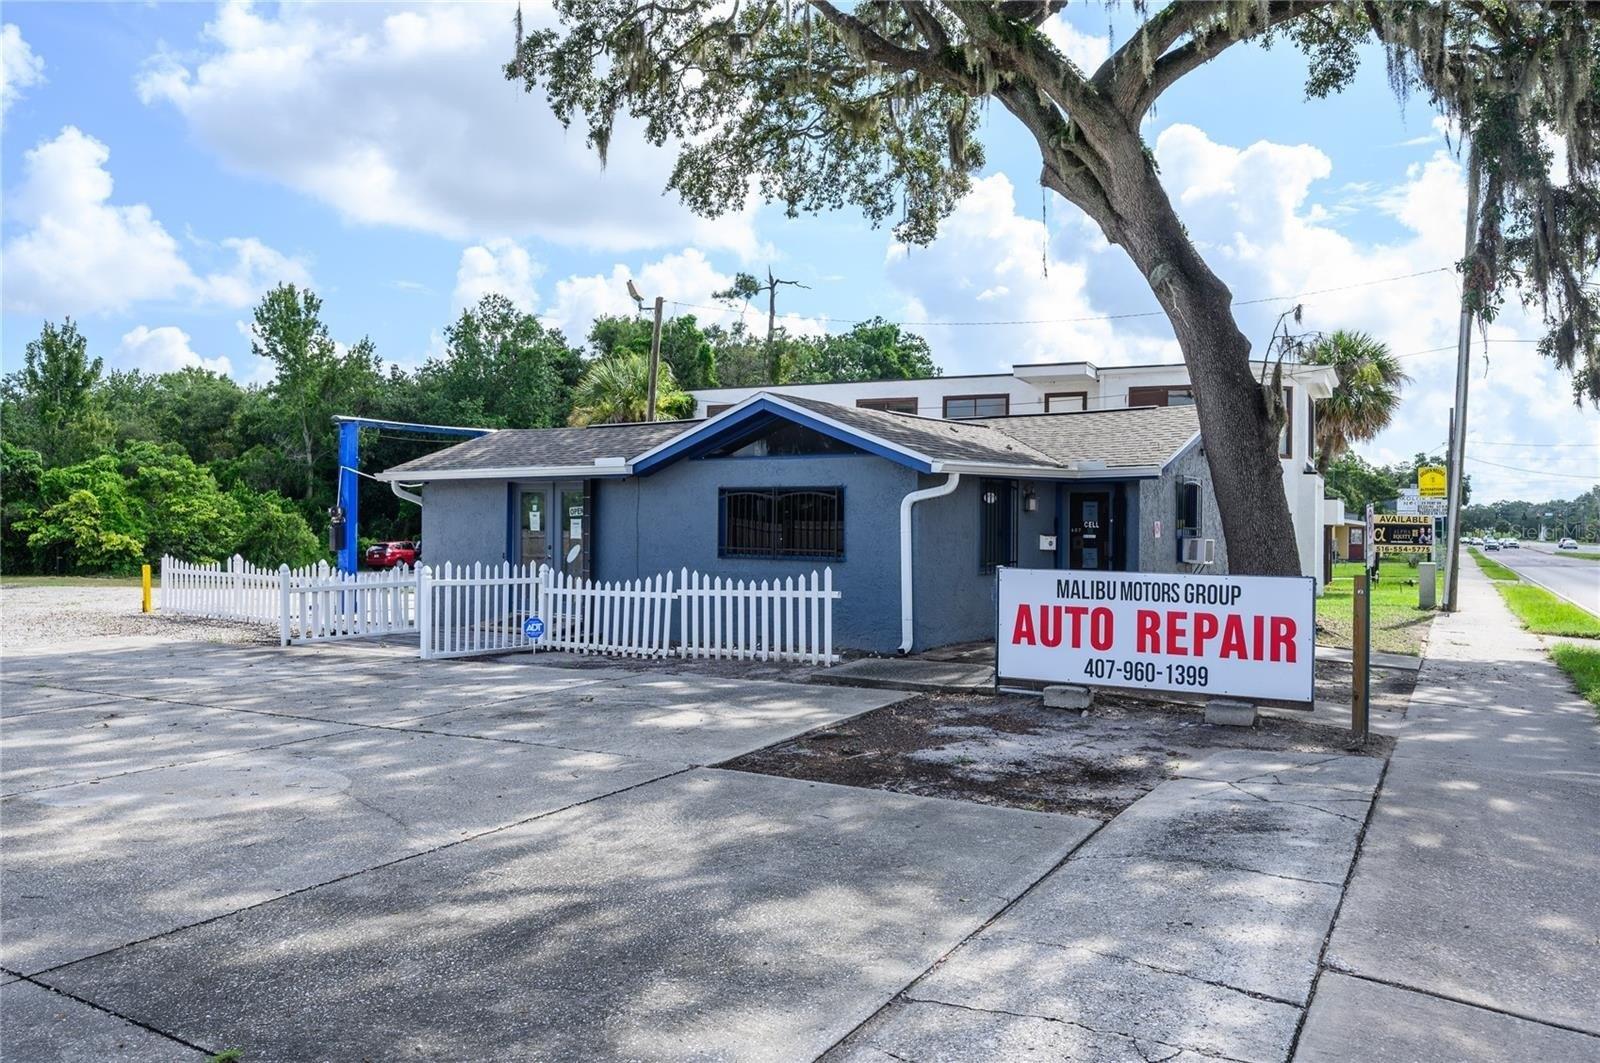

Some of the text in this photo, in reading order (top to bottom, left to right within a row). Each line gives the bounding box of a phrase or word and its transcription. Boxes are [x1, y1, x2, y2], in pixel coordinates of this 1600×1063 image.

[1379, 516, 1429, 524] AVAILABLE
[1056, 579, 1242, 606] MALIBU MOTORS GROUP
[526, 623, 543, 632] ADT
[1012, 604, 1297, 663] AUTO REPAIR
[1083, 658, 1209, 687] 407-960-1399
